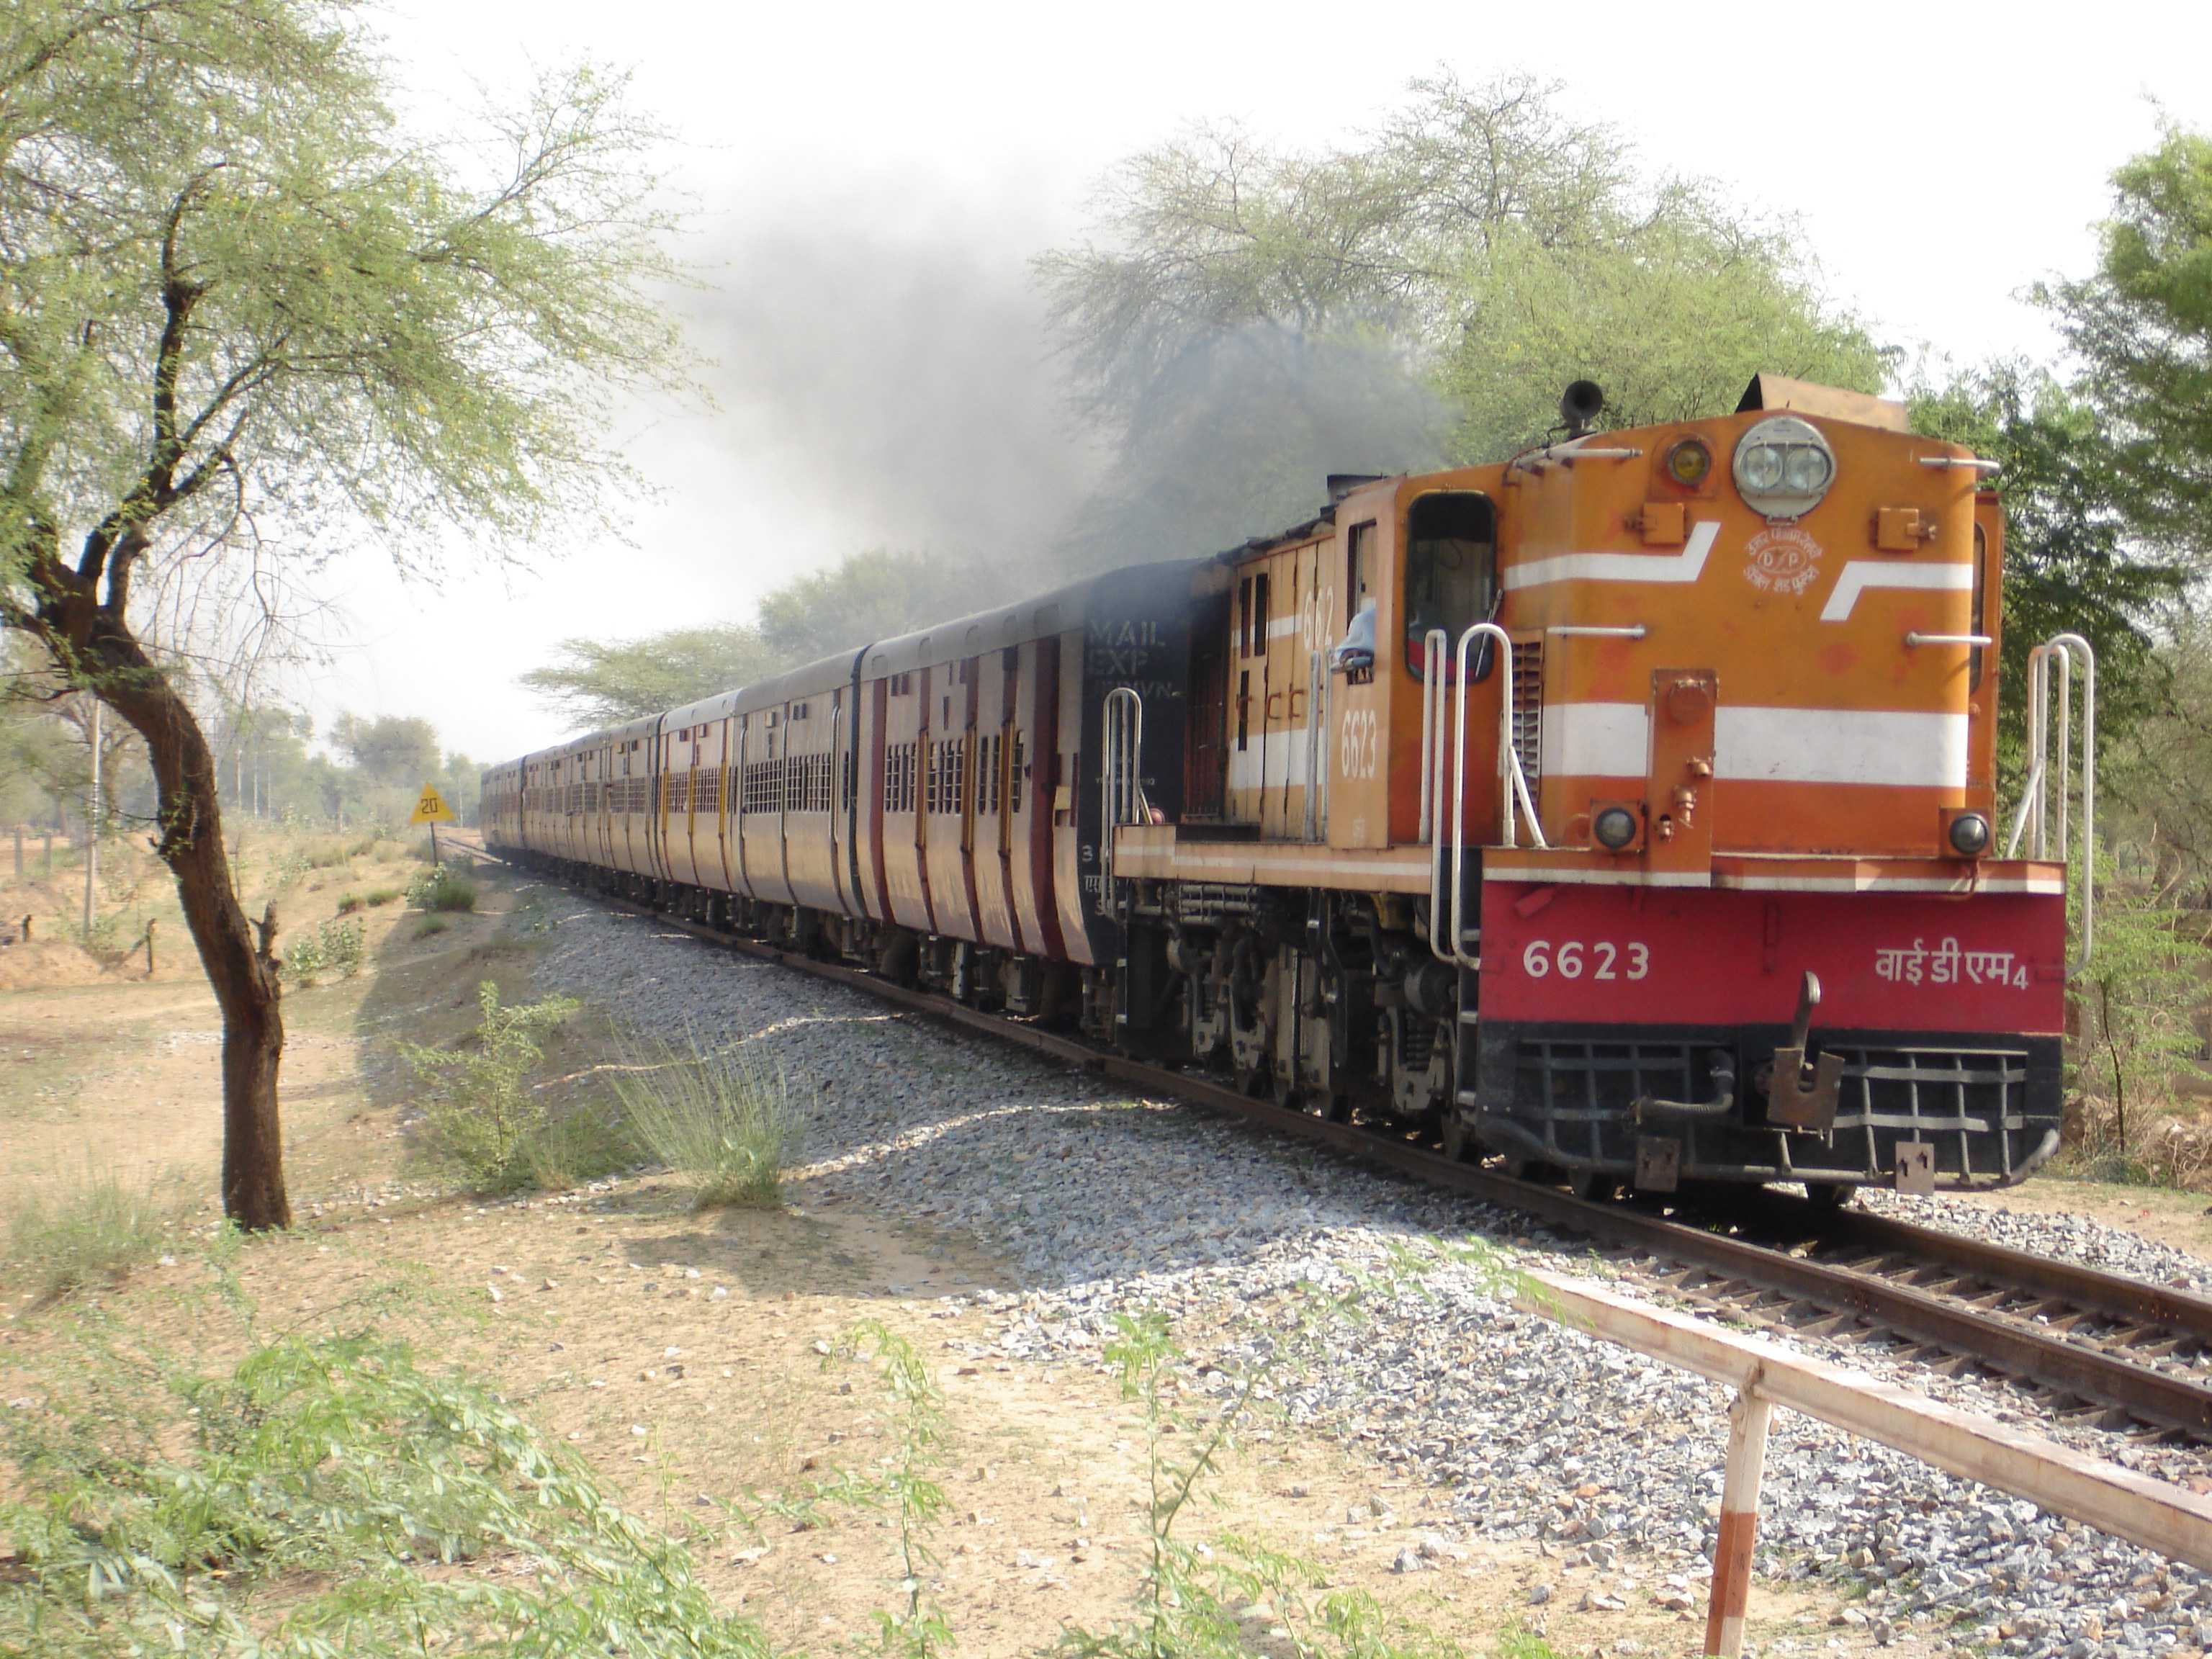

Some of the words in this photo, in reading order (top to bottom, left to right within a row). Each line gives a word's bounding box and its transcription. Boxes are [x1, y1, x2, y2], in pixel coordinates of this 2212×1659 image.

[1089, 620, 1165, 646] MAIL
[1088, 649, 1149, 675] EXP
[1341, 709, 1377, 779] 6623
[421, 797, 438, 814] 20
[1522, 939, 1650, 980] 6623
